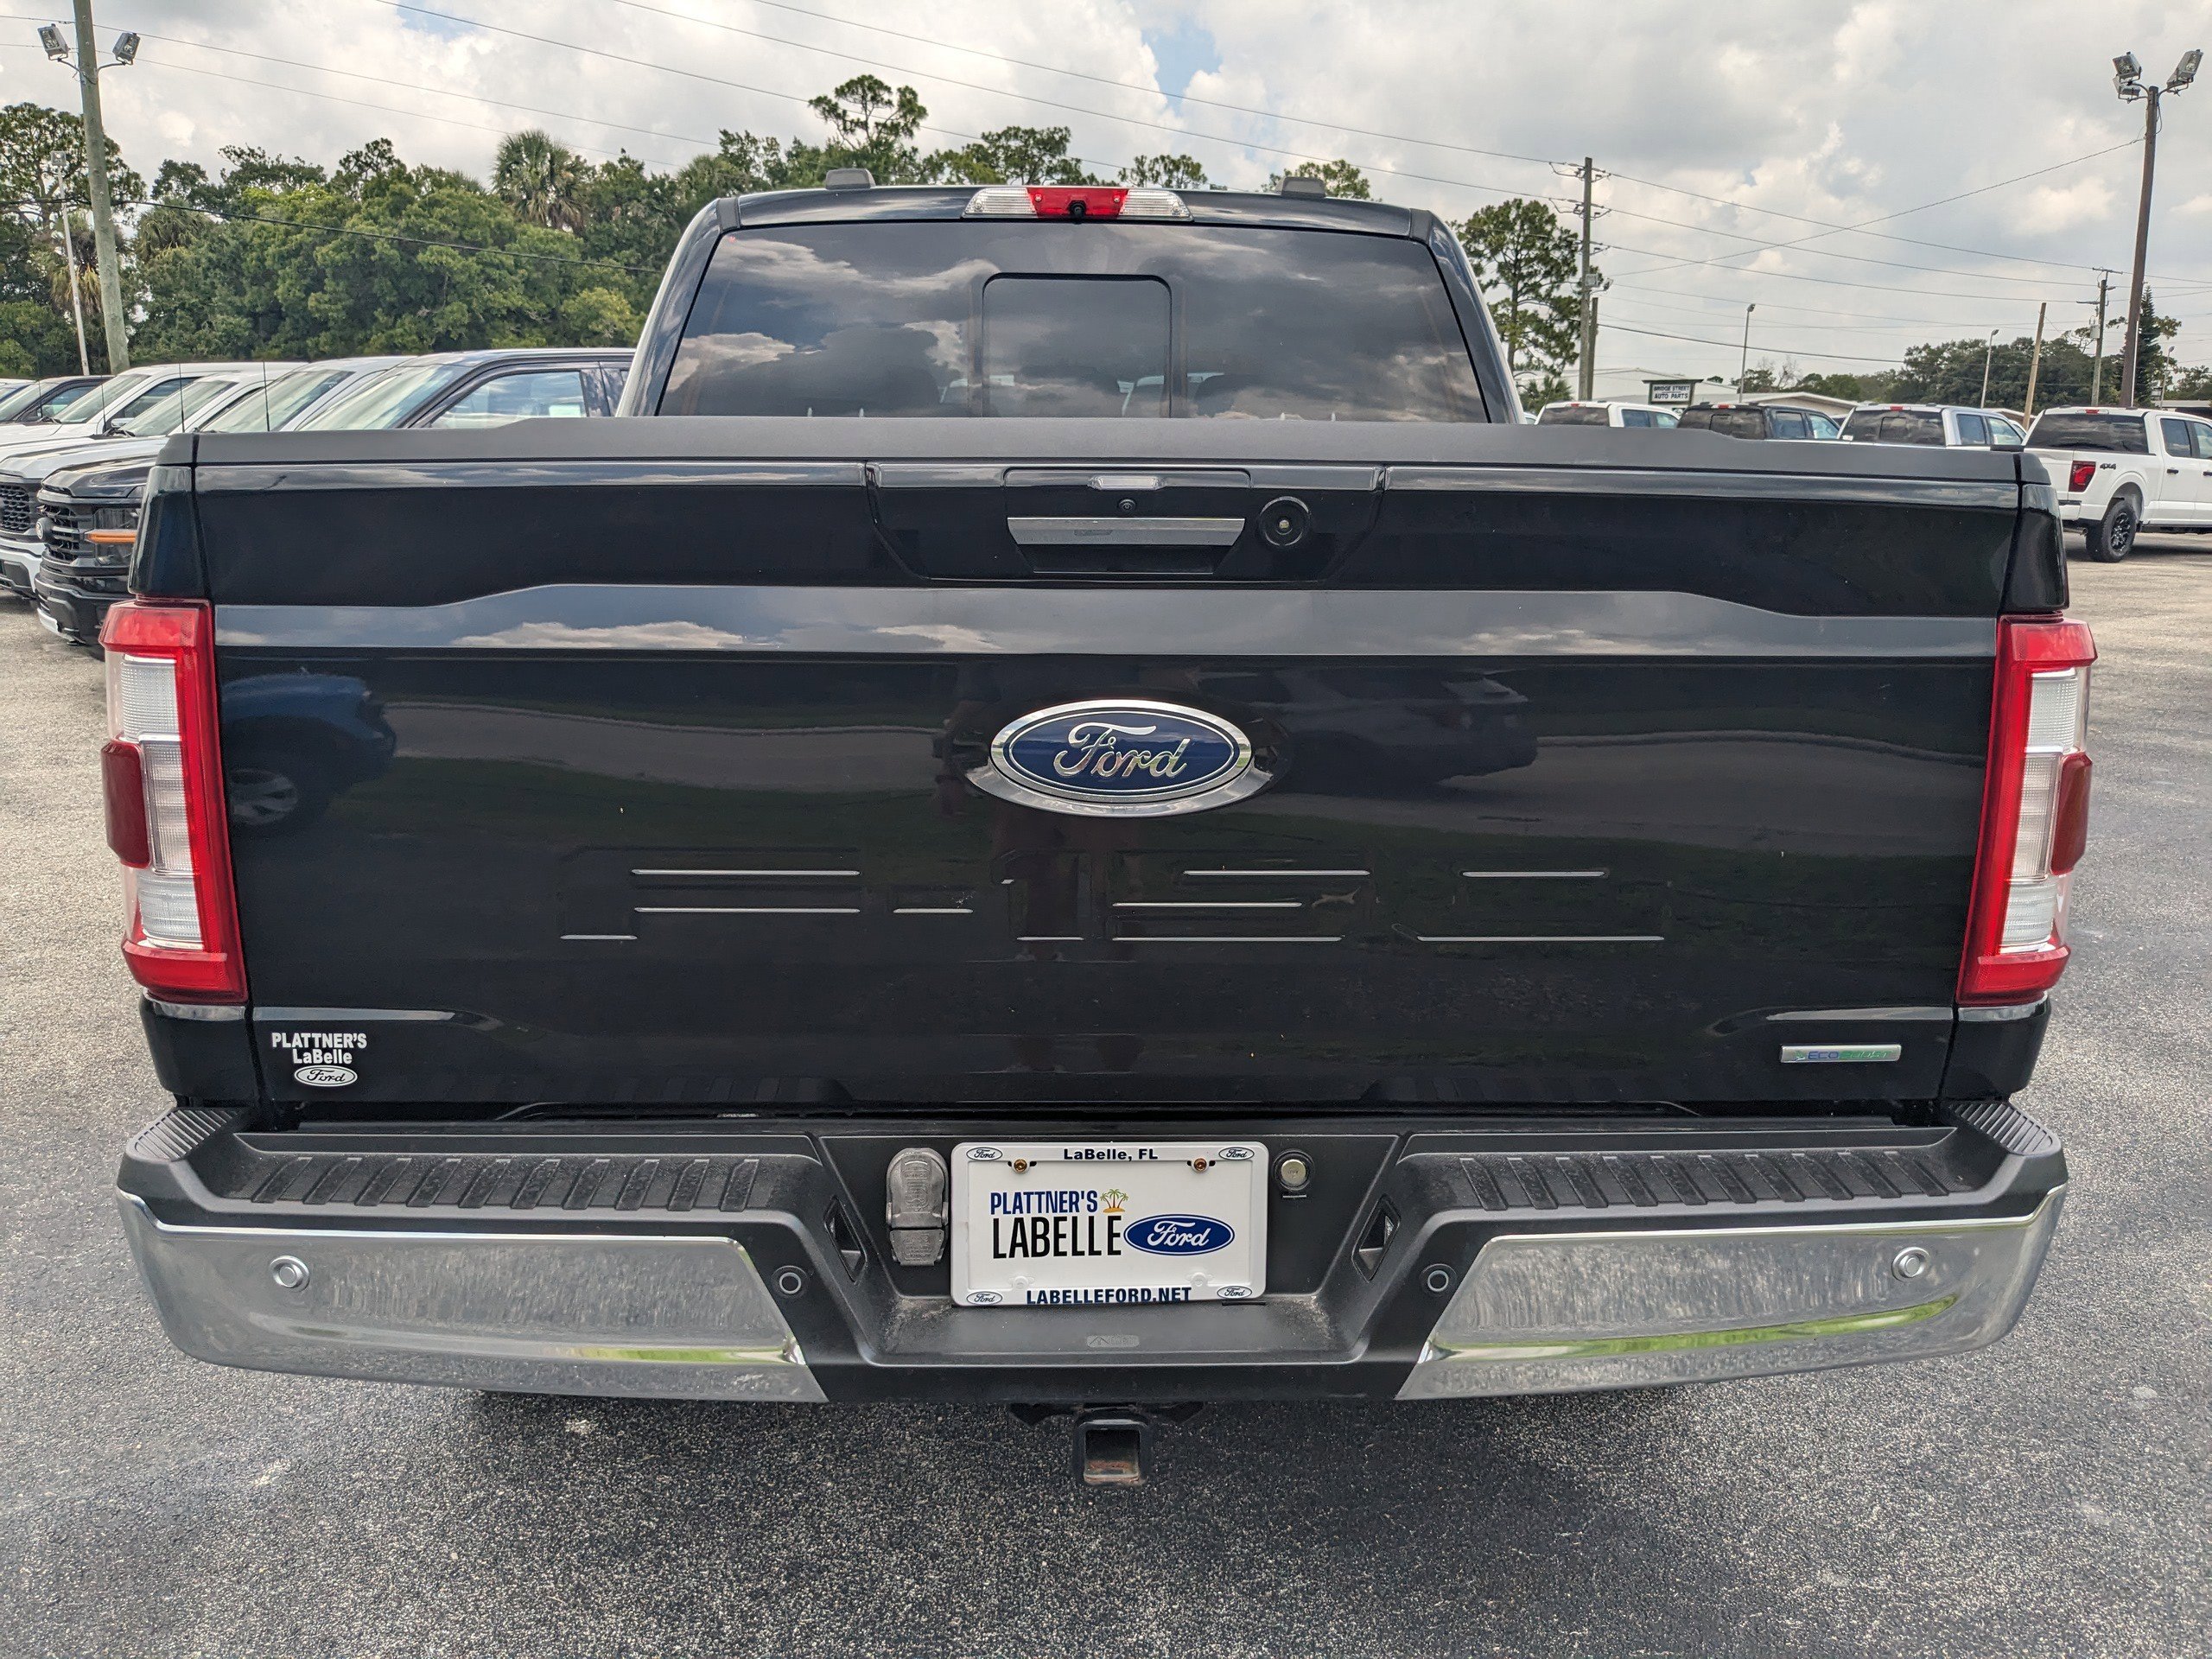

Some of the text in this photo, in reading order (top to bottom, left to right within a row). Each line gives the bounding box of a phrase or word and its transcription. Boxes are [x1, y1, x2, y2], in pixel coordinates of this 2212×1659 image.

[1052, 721, 1192, 779] Ford
[271, 1033, 367, 1048] PLATTNER'S
[292, 1048, 353, 1065] LaBelle
[307, 1069, 346, 1083] Ford
[973, 1148, 996, 1159] Ford
[1063, 1148, 1159, 1161] LaBelle, FL
[1225, 1148, 1248, 1159] Ford
[990, 1189, 1098, 1215] PLATTNER'S
[992, 1215, 1211, 1260] LABELLE Ford
[973, 1293, 995, 1303] Ford
[1026, 1287, 1192, 1305] LABELLEFORD.NET
[1224, 1287, 1246, 1297] Ford
